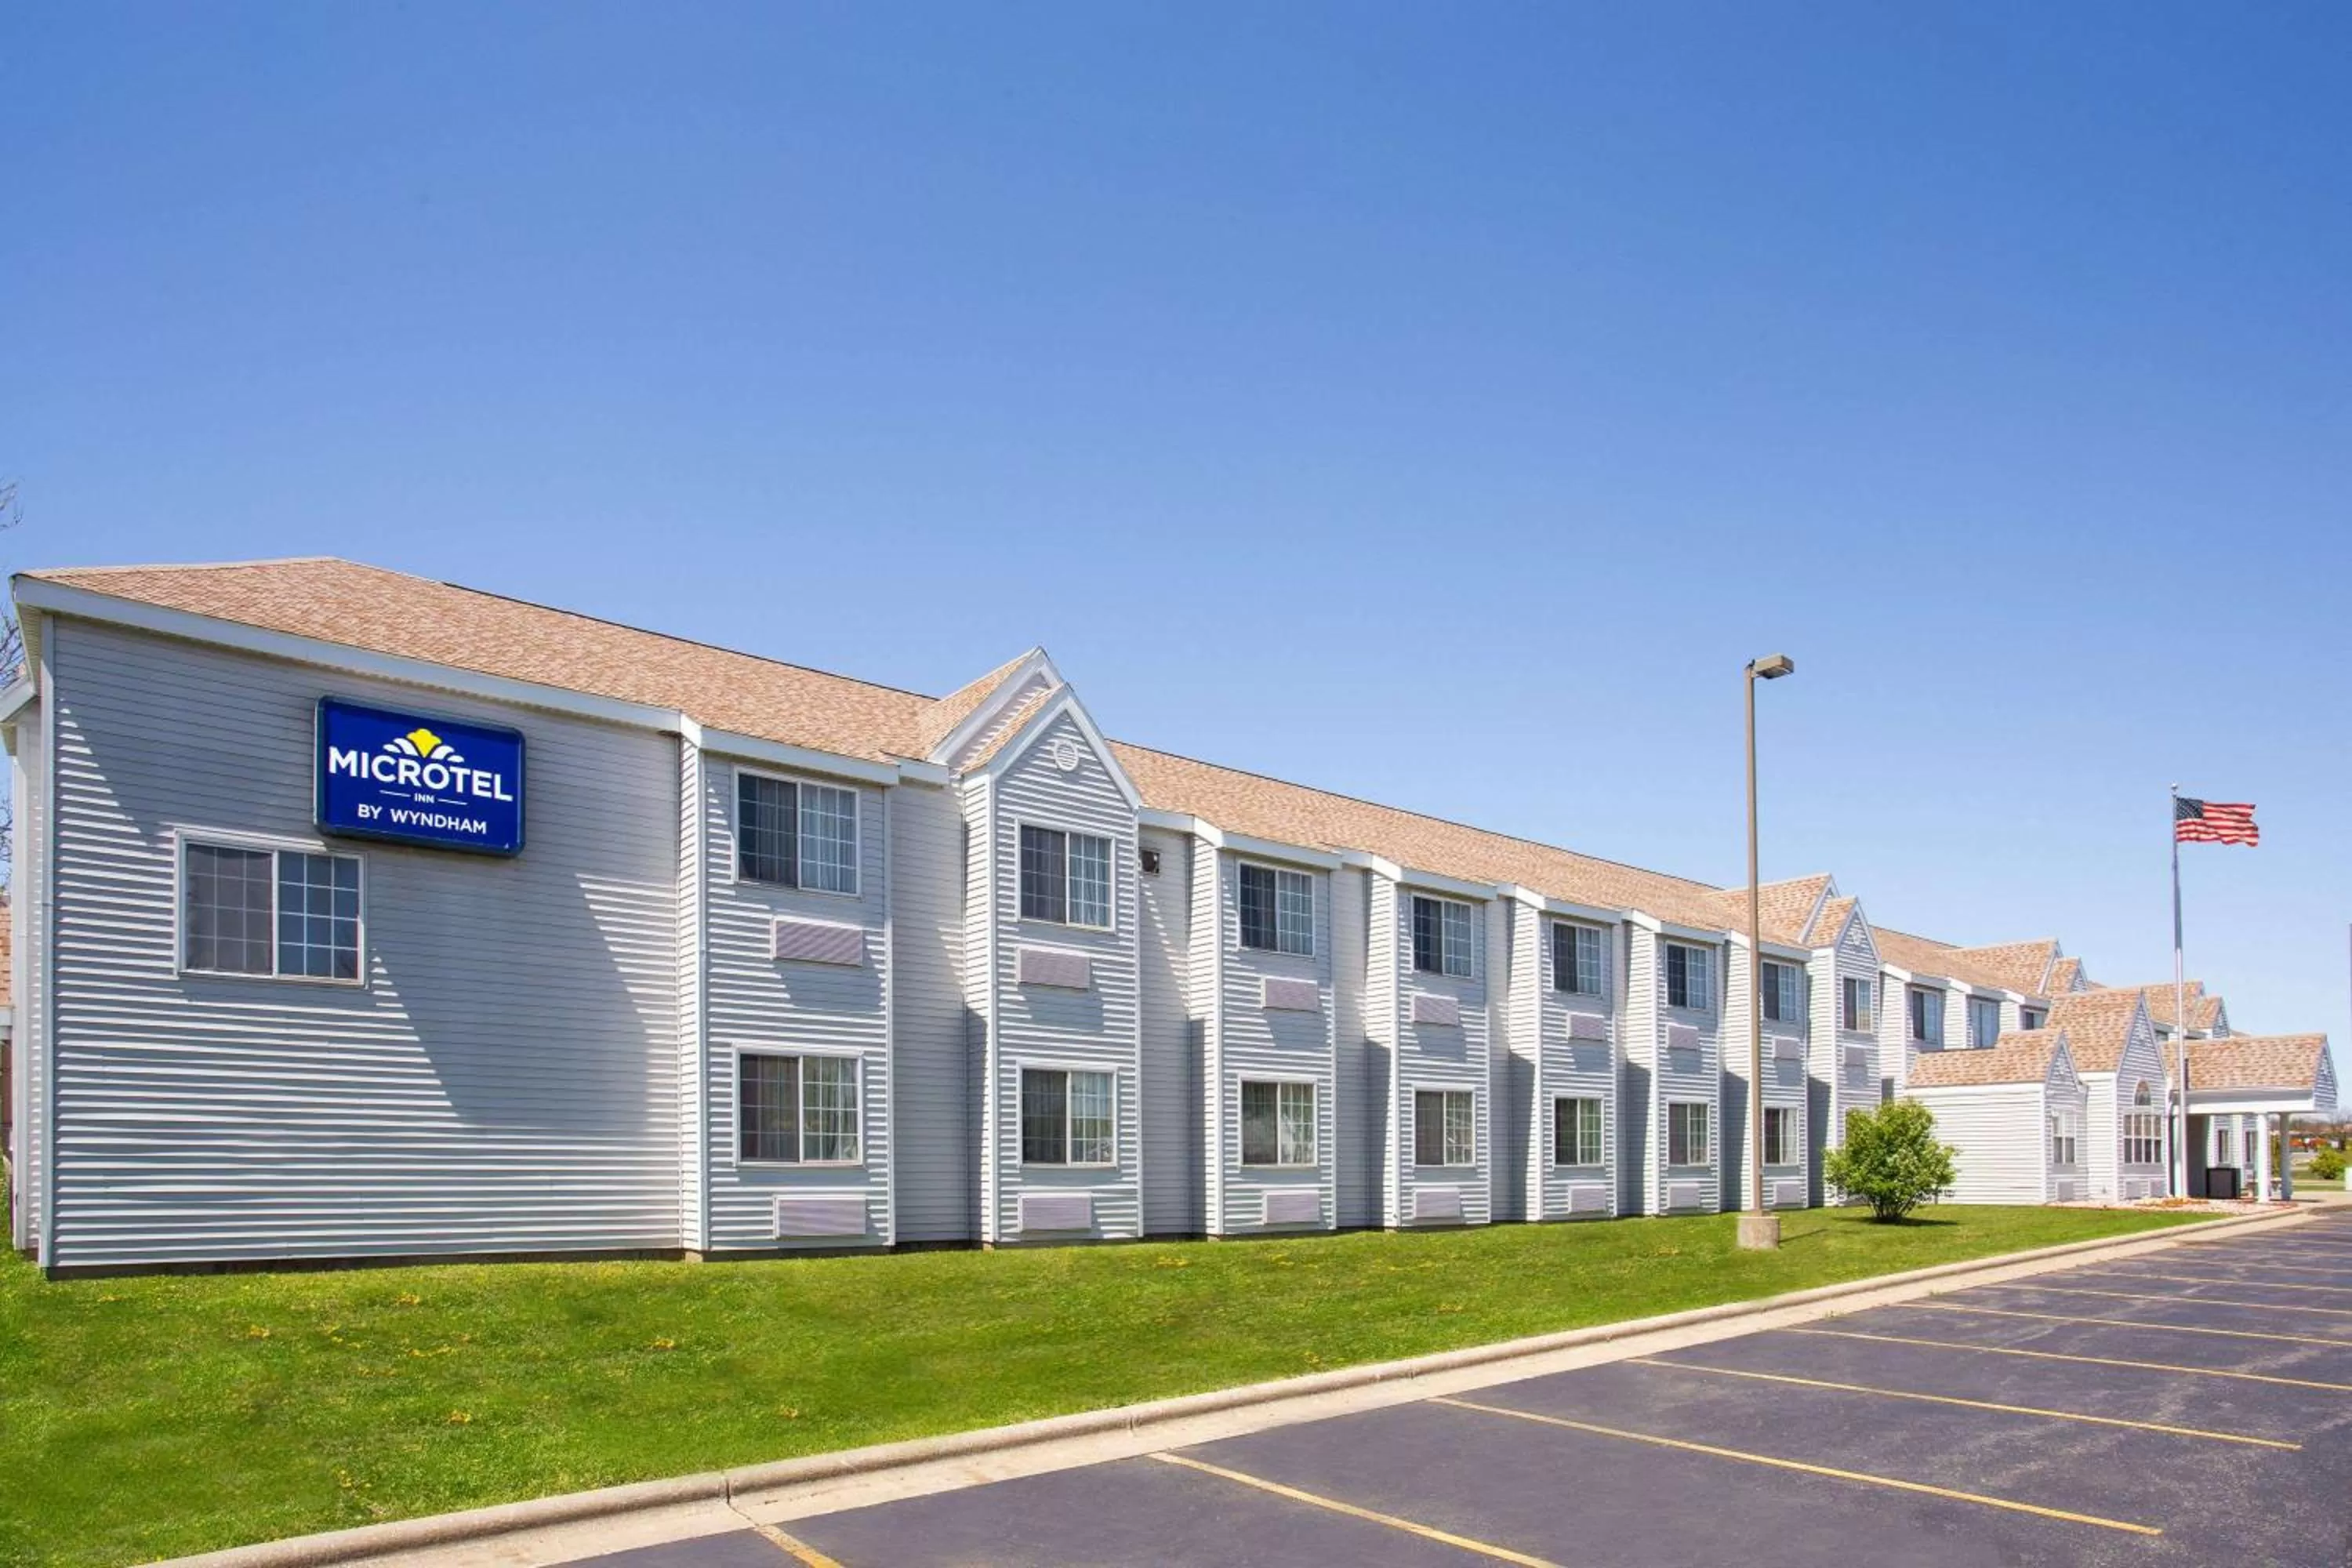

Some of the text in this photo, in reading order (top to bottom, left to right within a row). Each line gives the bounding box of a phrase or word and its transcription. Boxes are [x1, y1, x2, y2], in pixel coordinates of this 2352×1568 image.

[328, 746, 513, 801] MICROTEL
[414, 793, 434, 803] INN
[358, 804, 486, 833] BY WYNDHAM
